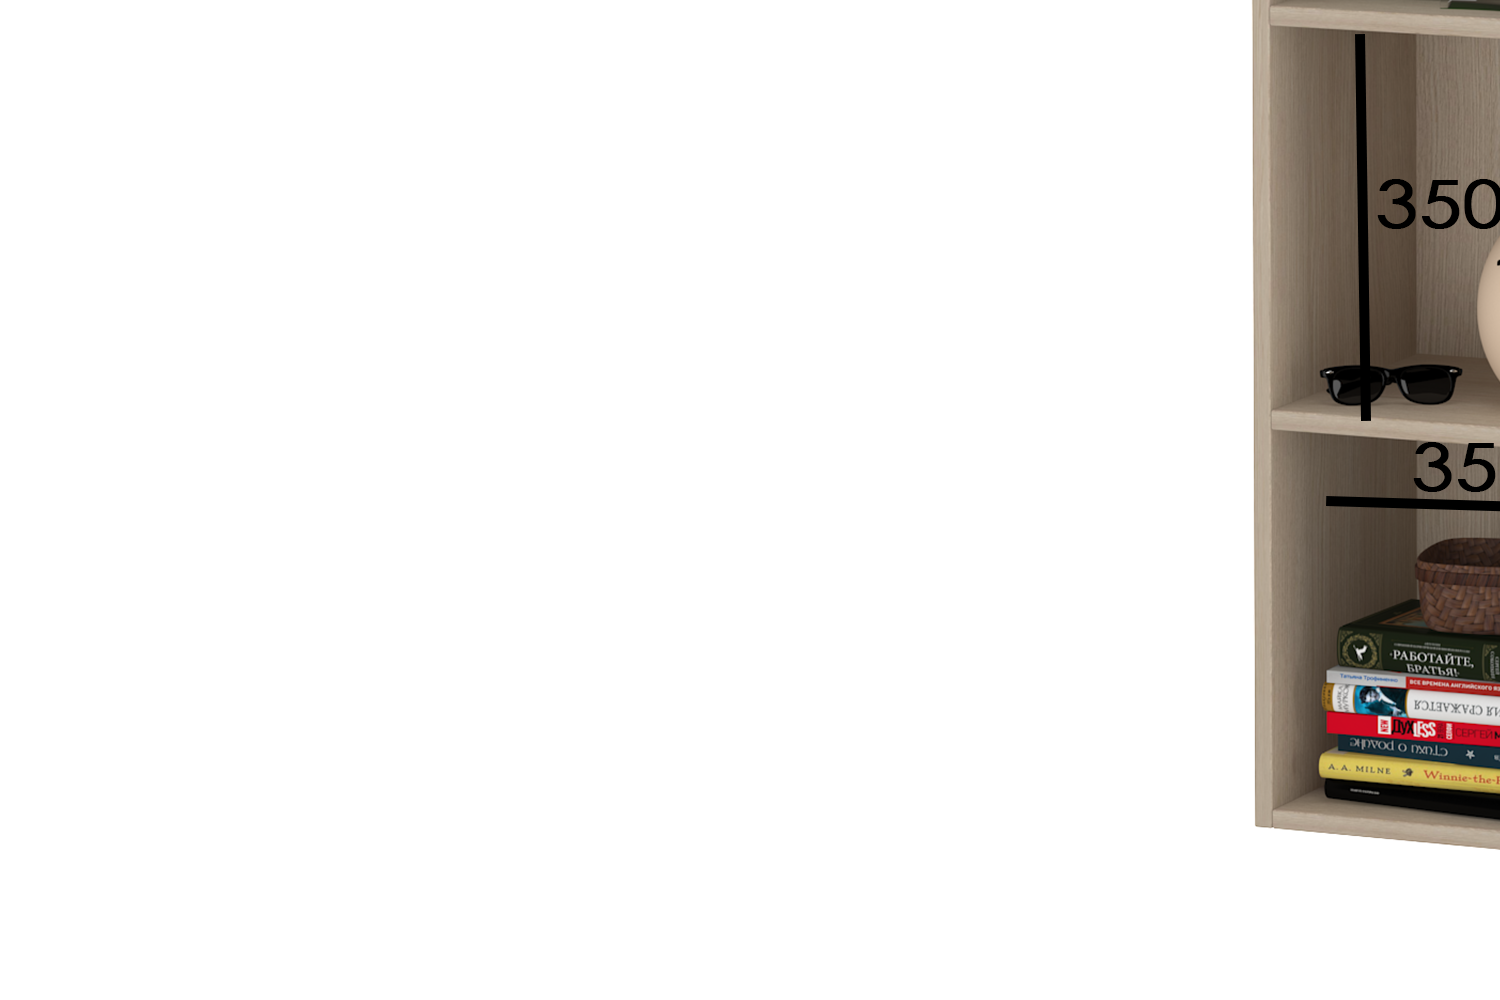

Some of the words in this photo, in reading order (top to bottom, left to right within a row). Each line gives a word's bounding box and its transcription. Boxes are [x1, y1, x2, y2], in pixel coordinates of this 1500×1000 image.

[1340, 673, 1363, 681] Татьяна
[1422, 680, 1450, 688] ВРЕМЕНА
[1450, 681, 1492, 691] АНГЛИЙСКОГО
[1414, 699, 1483, 716] СРАЖАЕТСЯ
[1380, 719, 1389, 733] NEW
[1455, 727, 1493, 740] СЕРГЕЙ
[1355, 766, 1391, 775] MILNE
